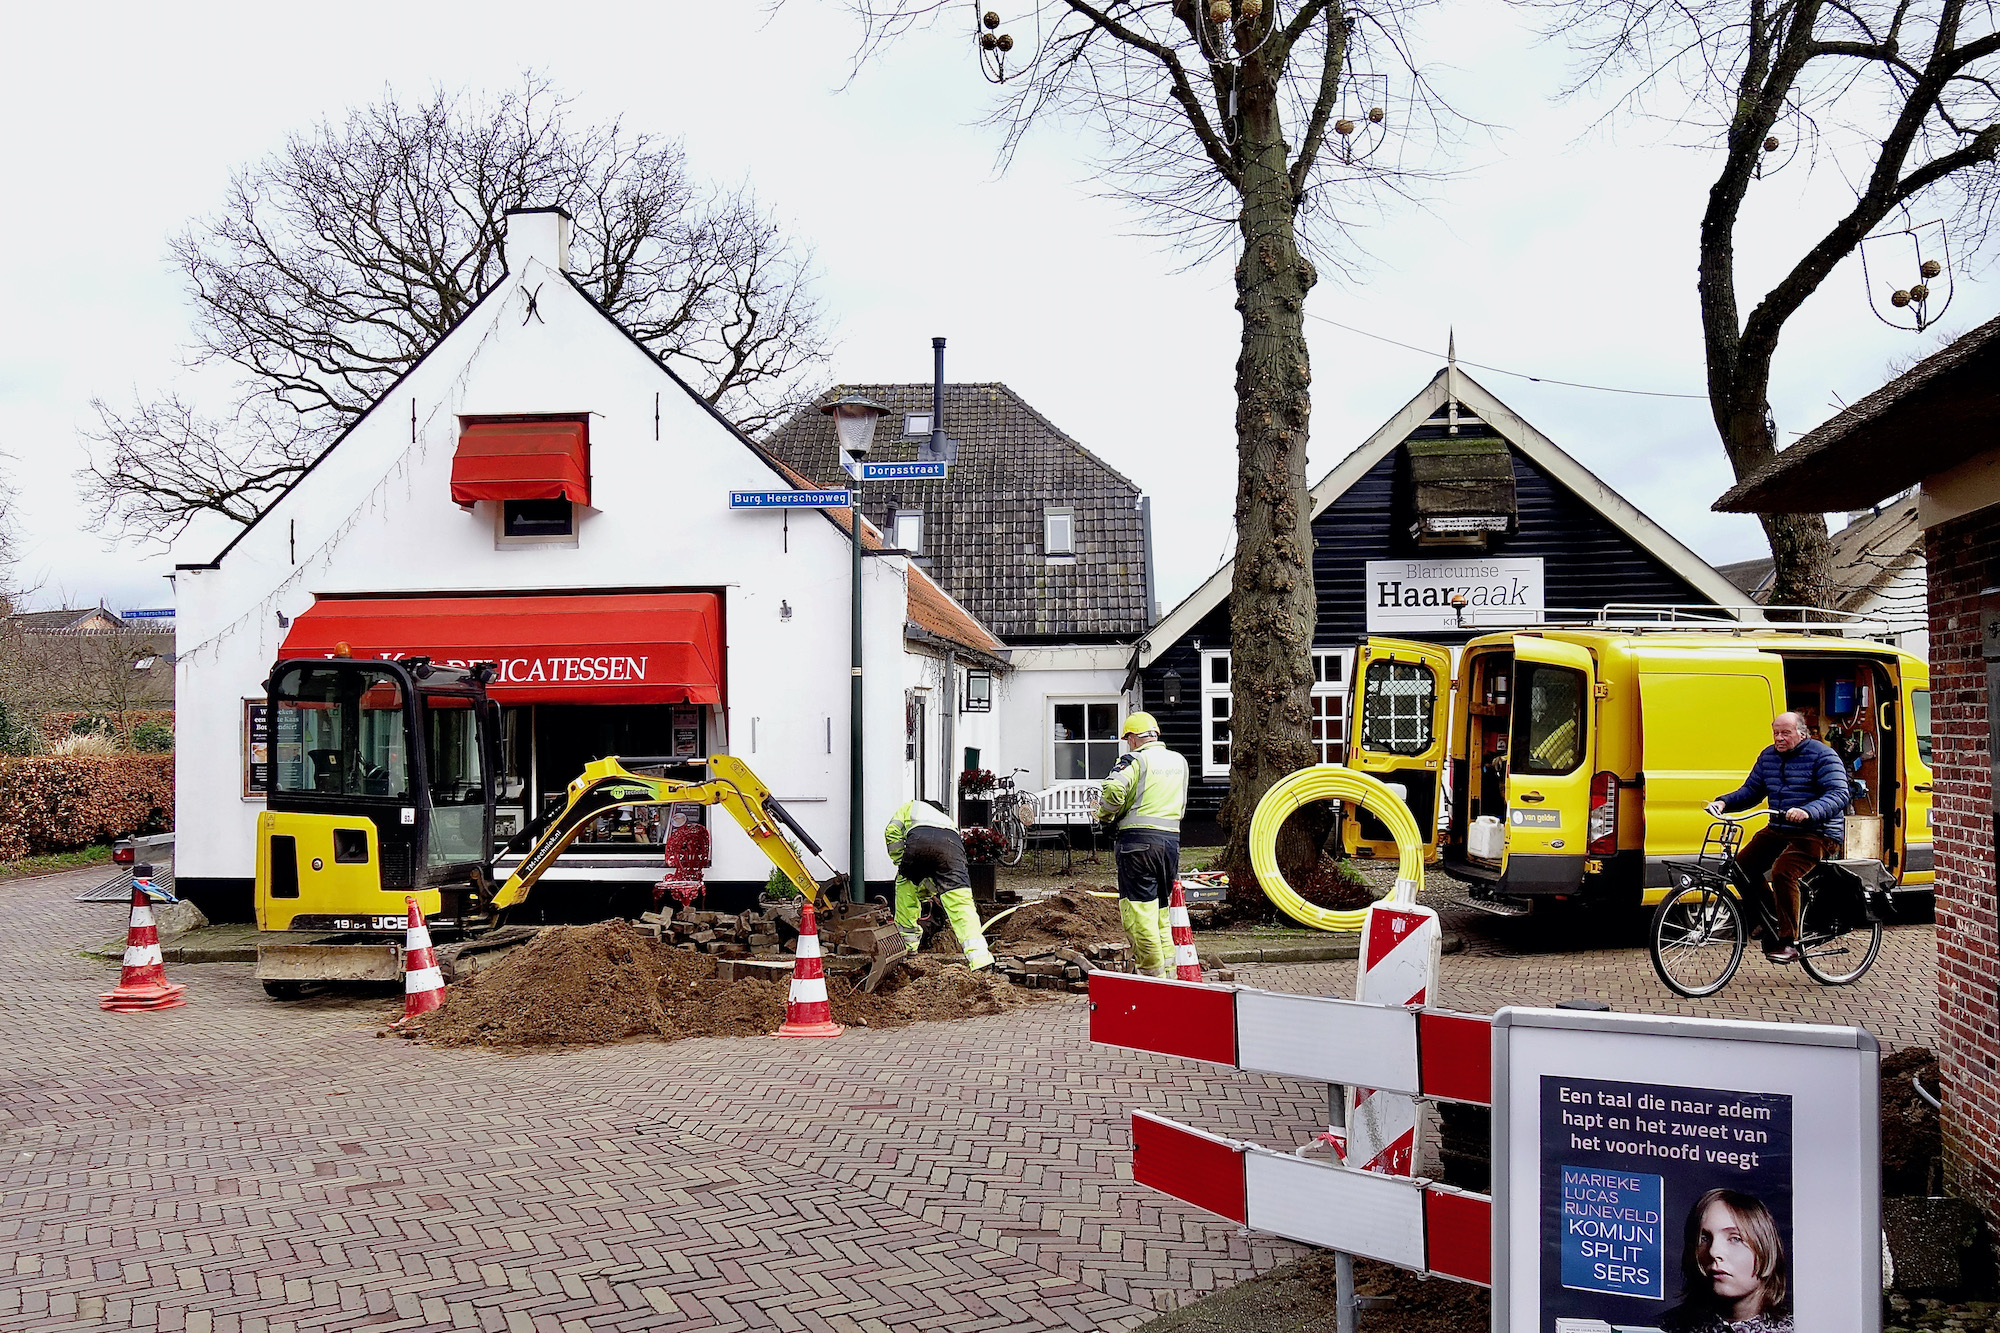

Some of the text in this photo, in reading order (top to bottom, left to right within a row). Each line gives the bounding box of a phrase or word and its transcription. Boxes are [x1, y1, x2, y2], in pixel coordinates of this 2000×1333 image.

[869, 465, 939, 476] Dorpsstraat
[734, 493, 846, 505] Burg. Heerschopweg
[1406, 563, 1499, 579] Blaricumse
[1377, 577, 1529, 608] Haarzaak
[1537, 813, 1556, 823] gelder
[526, 830, 561, 871] TM-techniek.nl
[1559, 1086, 1771, 1120] Een taal die naar adem
[1562, 1110, 1768, 1144] hapt en het zweet van
[1571, 1133, 1759, 1170] het voorhoofd veegt
[1565, 1171, 1640, 1192] MARIEKE
[1565, 1186, 1619, 1204] LUCAS
[1565, 1201, 1659, 1224] RIJNEVELD
[1569, 1218, 1653, 1245] KOMIJN
[1580, 1240, 1643, 1263] SPLIT
[1593, 1262, 1650, 1285] SERS
